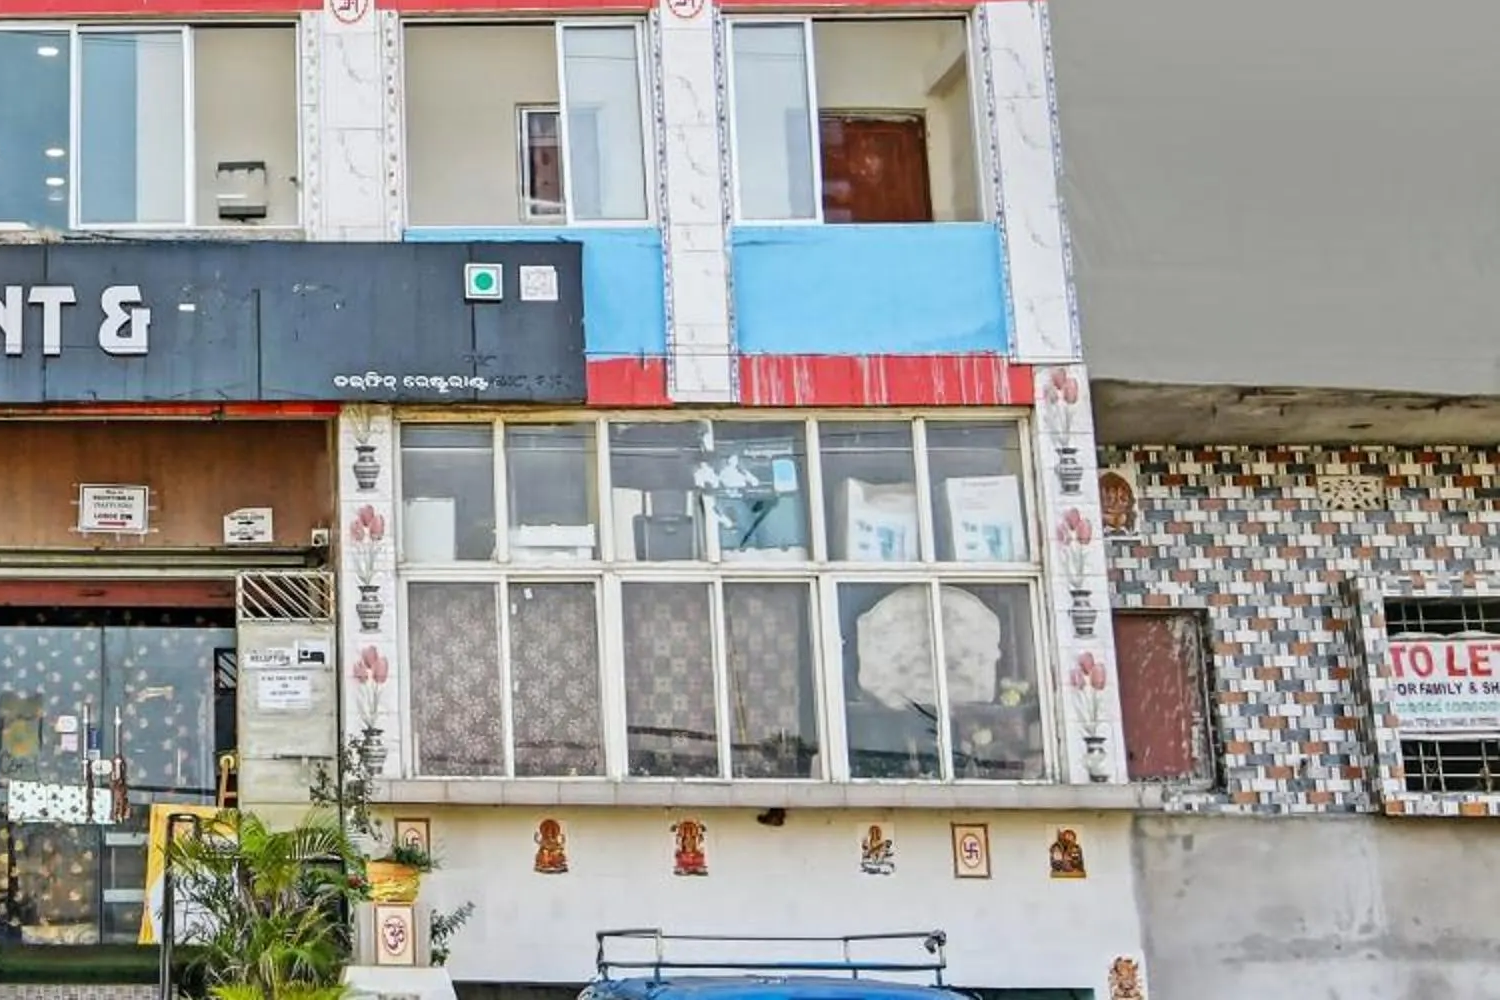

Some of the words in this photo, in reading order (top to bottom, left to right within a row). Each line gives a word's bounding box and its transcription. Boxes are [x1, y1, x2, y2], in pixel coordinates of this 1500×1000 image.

[98, 285, 152, 355] &
[1389, 644, 1433, 678] TO
[1393, 683, 1417, 696] OR
[1420, 682, 1462, 695] FAMILY
[1482, 681, 1500, 694] SH
